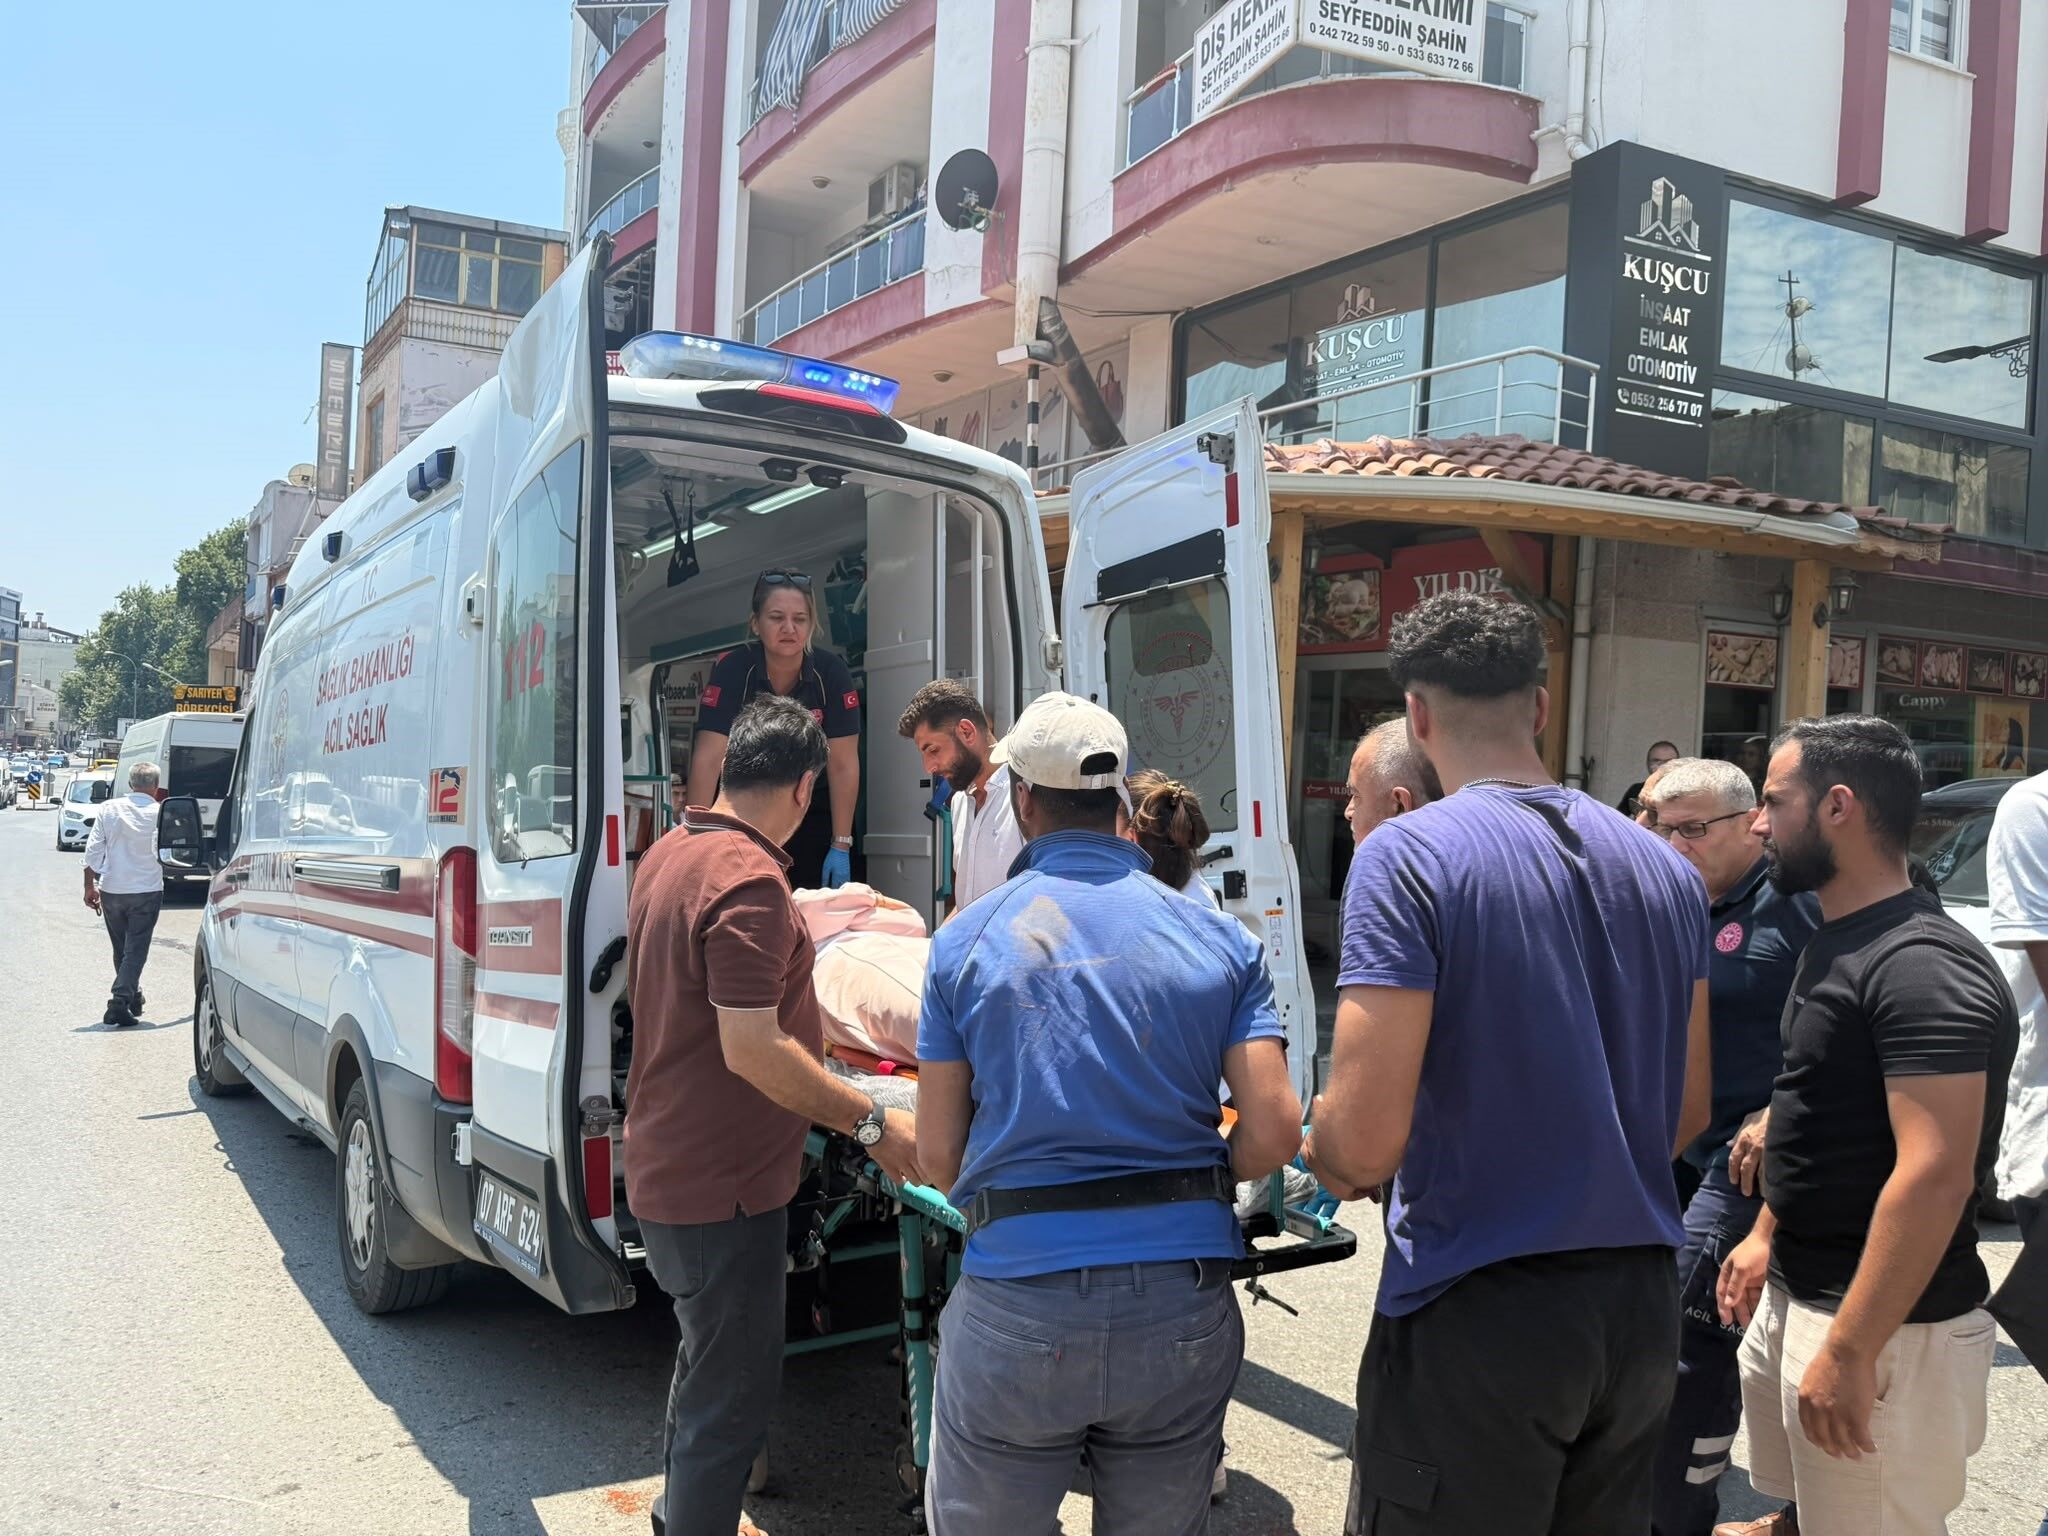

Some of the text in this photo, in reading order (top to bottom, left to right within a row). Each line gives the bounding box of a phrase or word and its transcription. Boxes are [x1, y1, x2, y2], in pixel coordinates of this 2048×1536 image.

[1200, 23, 1225, 69] DİŞ
[1201, 5, 1286, 93] SEYFEDDİN ŞAHİN
[1309, 22, 1316, 34] 0
[1319, 24, 1338, 40] 242
[1341, 29, 1359, 45] 722
[1362, 35, 1374, 48] 59
[1377, 39, 1389, 52] 50
[1398, 44, 1404, 55] 0
[1406, 47, 1425, 61] 533
[1427, 52, 1445, 68] 633
[1448, 57, 1459, 70] 72
[1461, 61, 1474, 74] 66
[1319, 0, 1466, 54] SEYFEDDİN ŞAHİN
[1622, 252, 1711, 295] KUŞCU
[1639, 293, 1691, 327] İNŞAAT
[1306, 314, 1407, 366] KUŞCU
[1639, 327, 1689, 355] EMLAK
[1334, 363, 1360, 377] EMLAK
[1366, 350, 1405, 368] OTOMOTİV
[1627, 353, 1698, 385] OTOMOTİV
[1630, 391, 1655, 409] 0552
[1657, 397, 1675, 413] 256
[1676, 400, 1689, 415] 77
[1690, 402, 1703, 418] 07
[316, 624, 415, 708] SAĞLIK BAKANLIĞI
[504, 622, 545, 702] 112
[187, 687, 223, 699] SARIYER
[1899, 694, 1951, 711] Cappy
[323, 698, 389, 755] ACİL SAĞLIK
[480, 1180, 495, 1222] 07
[493, 1189, 517, 1237] ARF
[518, 1204, 541, 1258] 624
